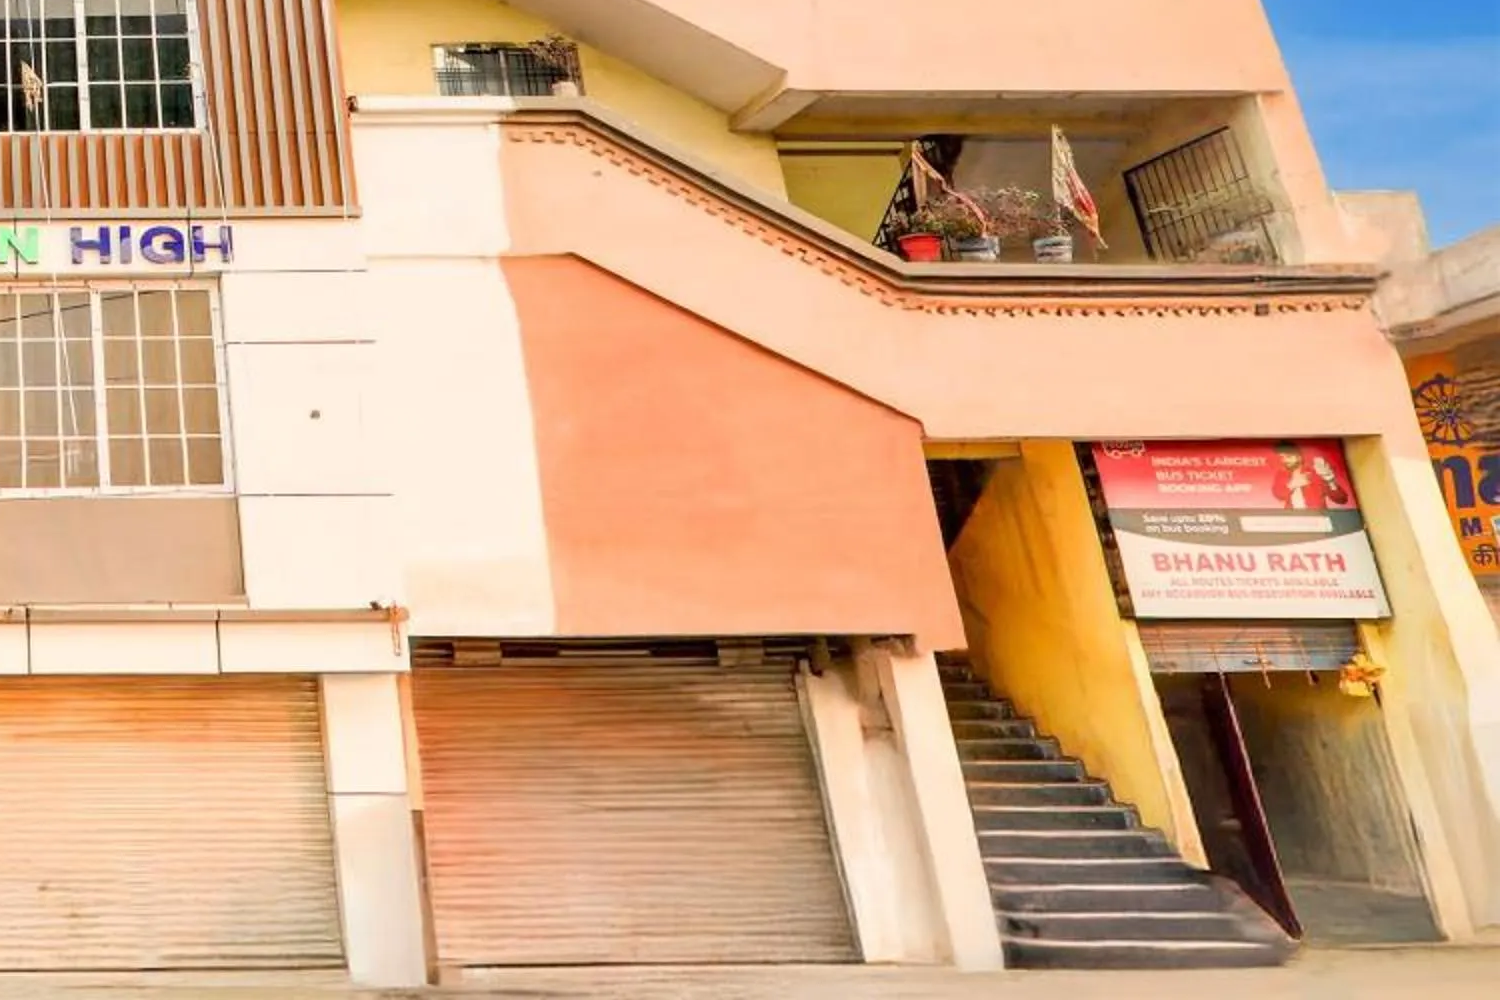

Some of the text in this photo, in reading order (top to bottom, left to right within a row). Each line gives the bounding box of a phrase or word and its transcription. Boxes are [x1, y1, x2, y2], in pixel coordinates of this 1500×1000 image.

[69, 224, 233, 265] HIGH
[1152, 552, 1347, 573] BHANU RATH
